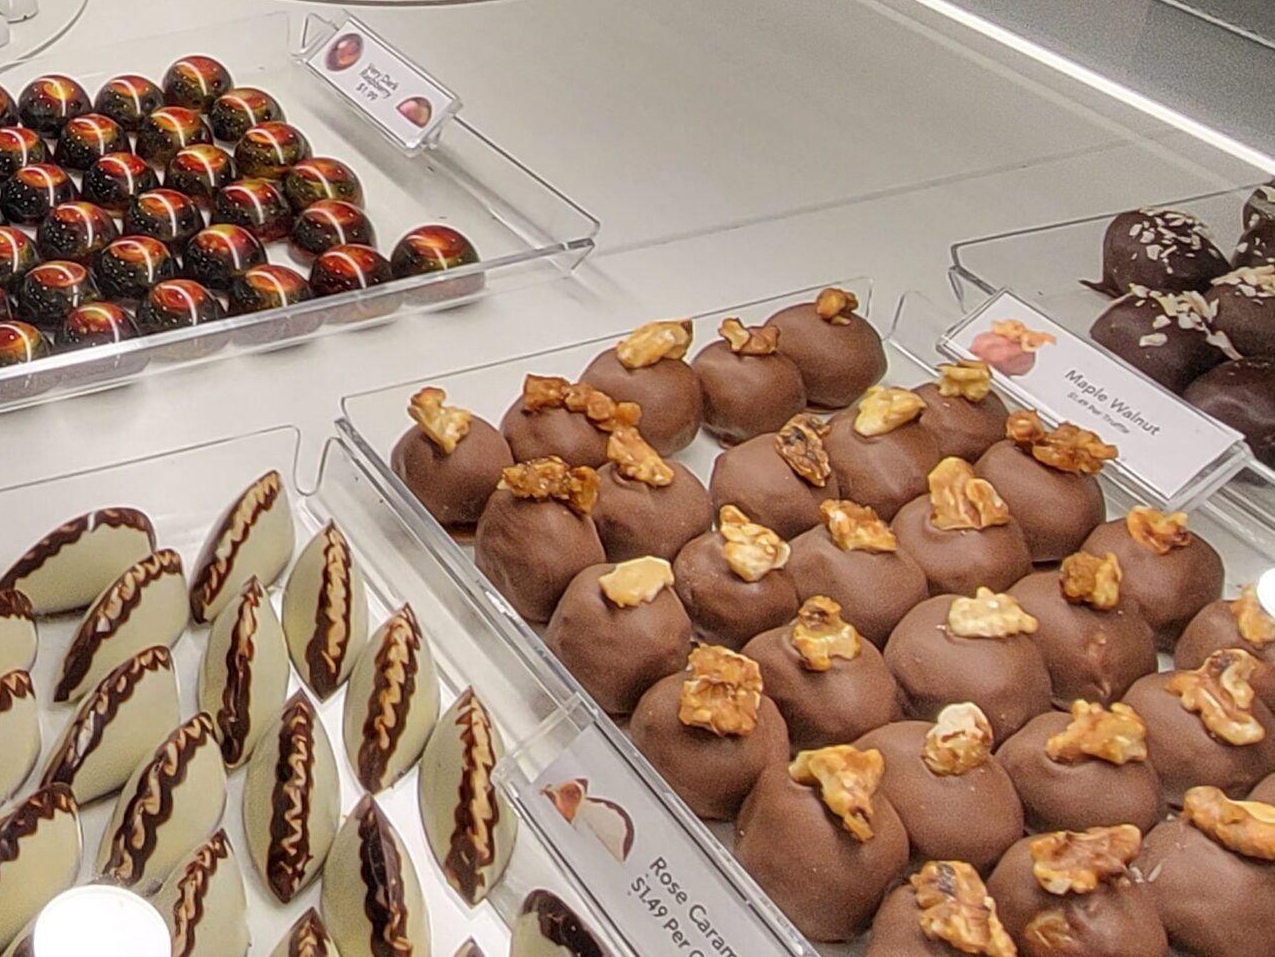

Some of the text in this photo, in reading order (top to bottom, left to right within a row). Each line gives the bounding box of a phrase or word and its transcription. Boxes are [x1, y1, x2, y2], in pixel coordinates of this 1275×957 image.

[1063, 369, 1161, 436] Maple Walnut
[627, 873, 691, 949] $1.49 Per
[649, 856, 688, 905] Rose
